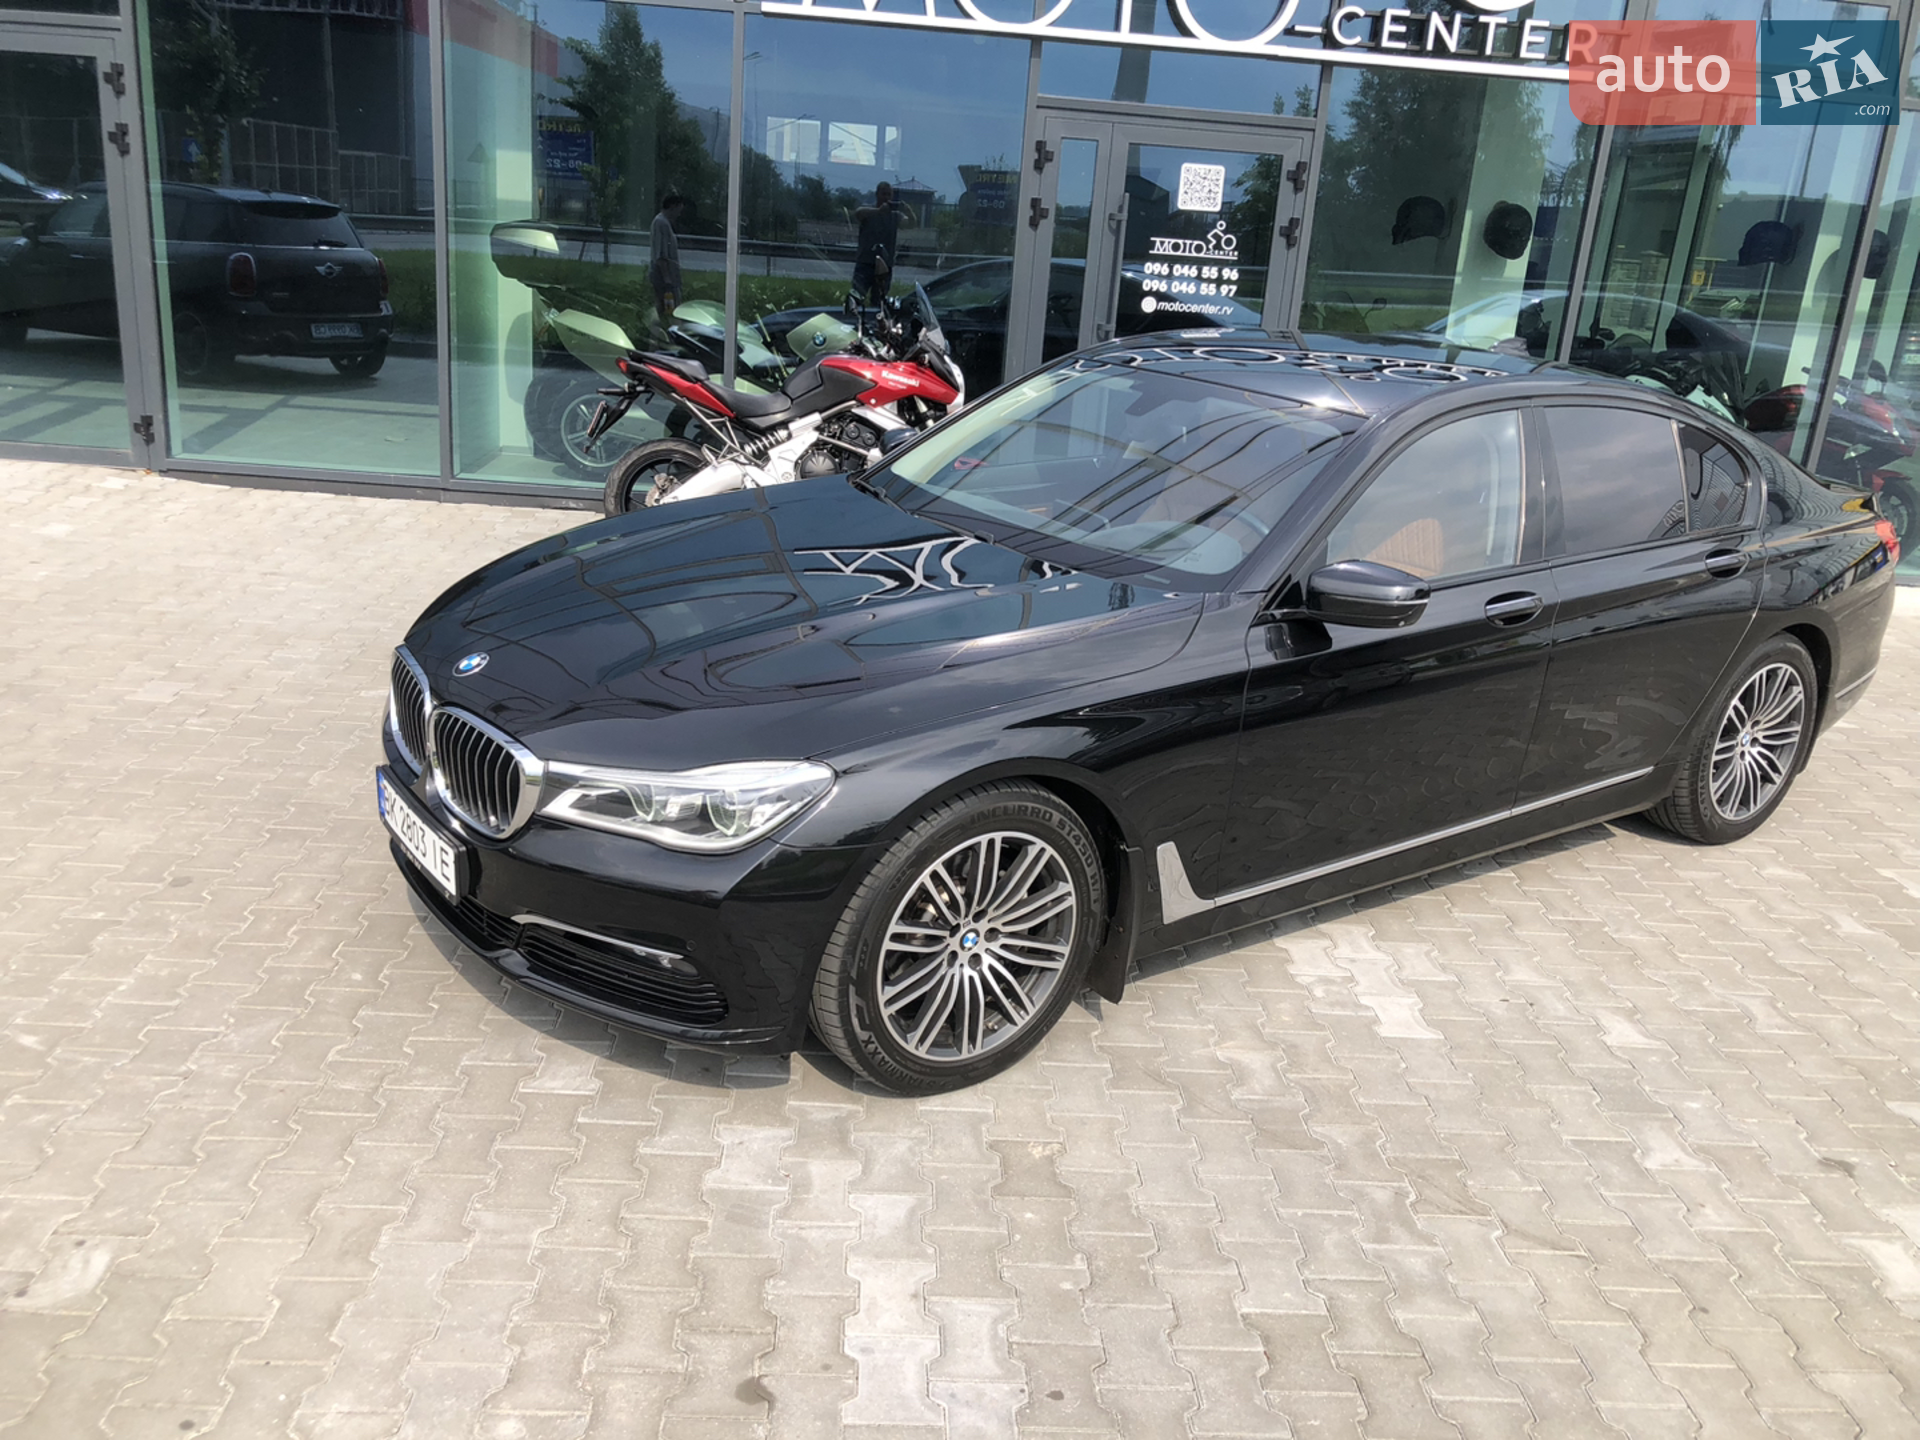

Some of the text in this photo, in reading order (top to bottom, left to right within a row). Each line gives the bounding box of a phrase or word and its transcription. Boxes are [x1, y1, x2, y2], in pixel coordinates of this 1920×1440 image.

[1331, 5, 1598, 64] CENTER
[1154, 238, 1207, 256] MOTO
[1143, 262, 1240, 281] 096 046 55 96
[1142, 278, 1238, 297] 096 046 55 97
[1157, 301, 1234, 315] motocenter.rv
[970, 803, 1054, 825] INCURRO
[399, 804, 428, 859] 2803
[432, 838, 452, 884] IE
